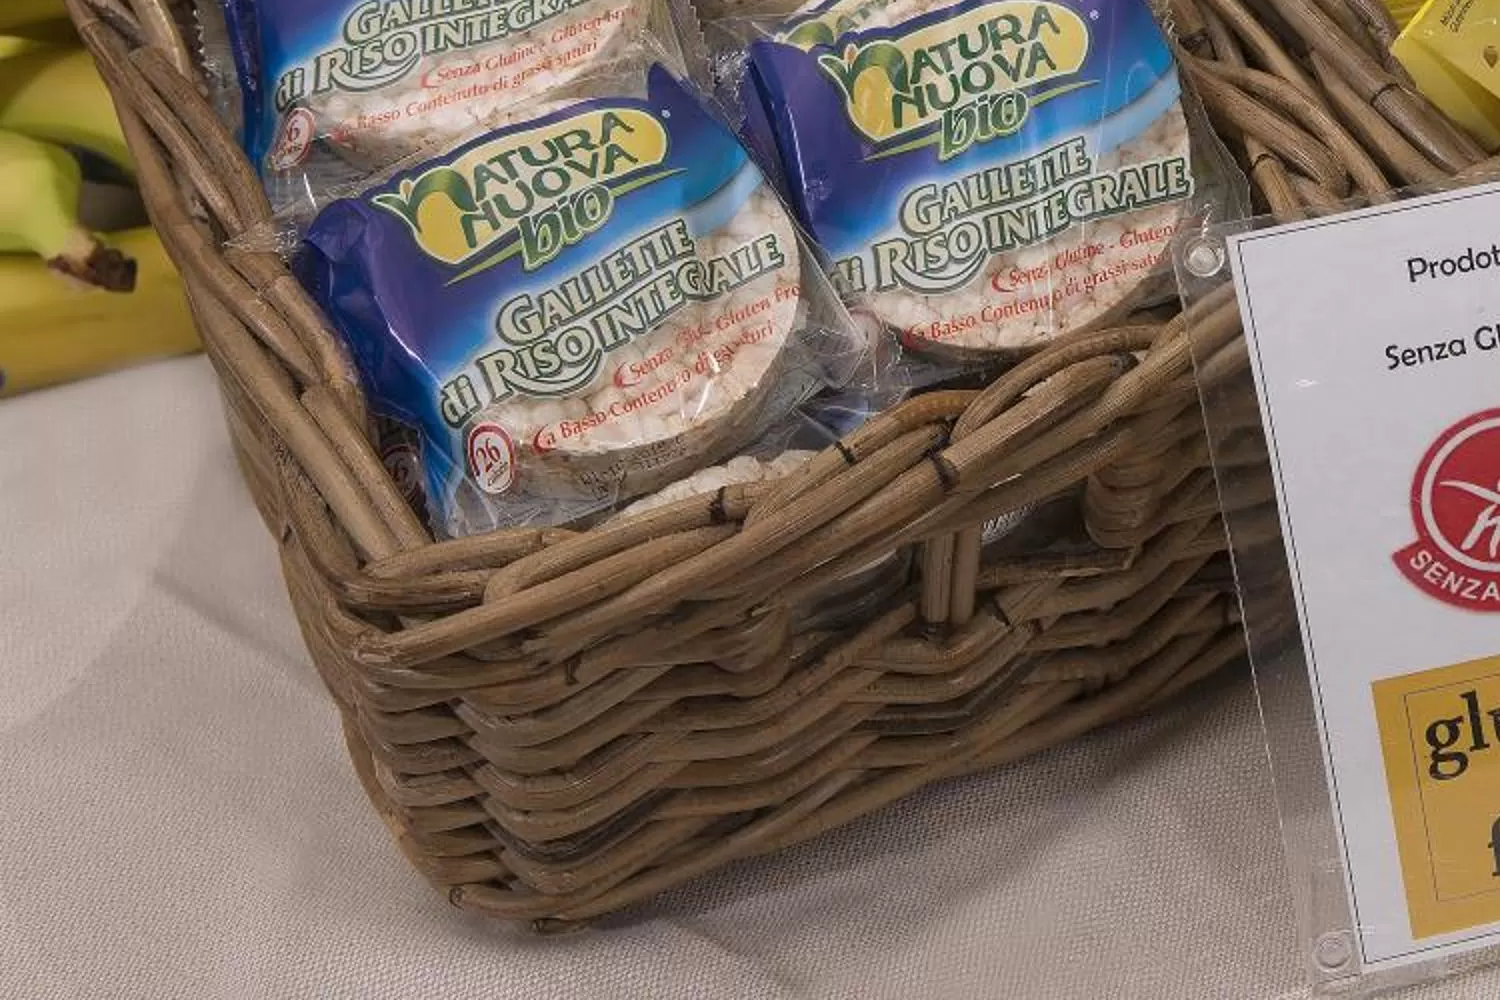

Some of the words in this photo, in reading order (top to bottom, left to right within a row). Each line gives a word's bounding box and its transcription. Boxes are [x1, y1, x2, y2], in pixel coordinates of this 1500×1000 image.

[275, 68, 306, 111] di
[314, 29, 423, 93] RISO
[824, 6, 1060, 101] NATURA
[892, 46, 1057, 130] NUOVA
[939, 93, 1028, 162] bio
[376, 111, 634, 232] NATURA
[460, 145, 639, 248] NUOVA
[900, 137, 1090, 237] GALLETTE
[520, 186, 613, 272] bio
[873, 226, 988, 294] RISO
[986, 158, 1194, 254] INTEGRALE
[495, 218, 697, 346] GALLETTE
[930, 317, 976, 339] Basso
[1385, 337, 1467, 371] Senza
[440, 374, 482, 429] di
[478, 325, 604, 400] RISO
[475, 437, 502, 473] 26
[560, 410, 606, 438] Basso
